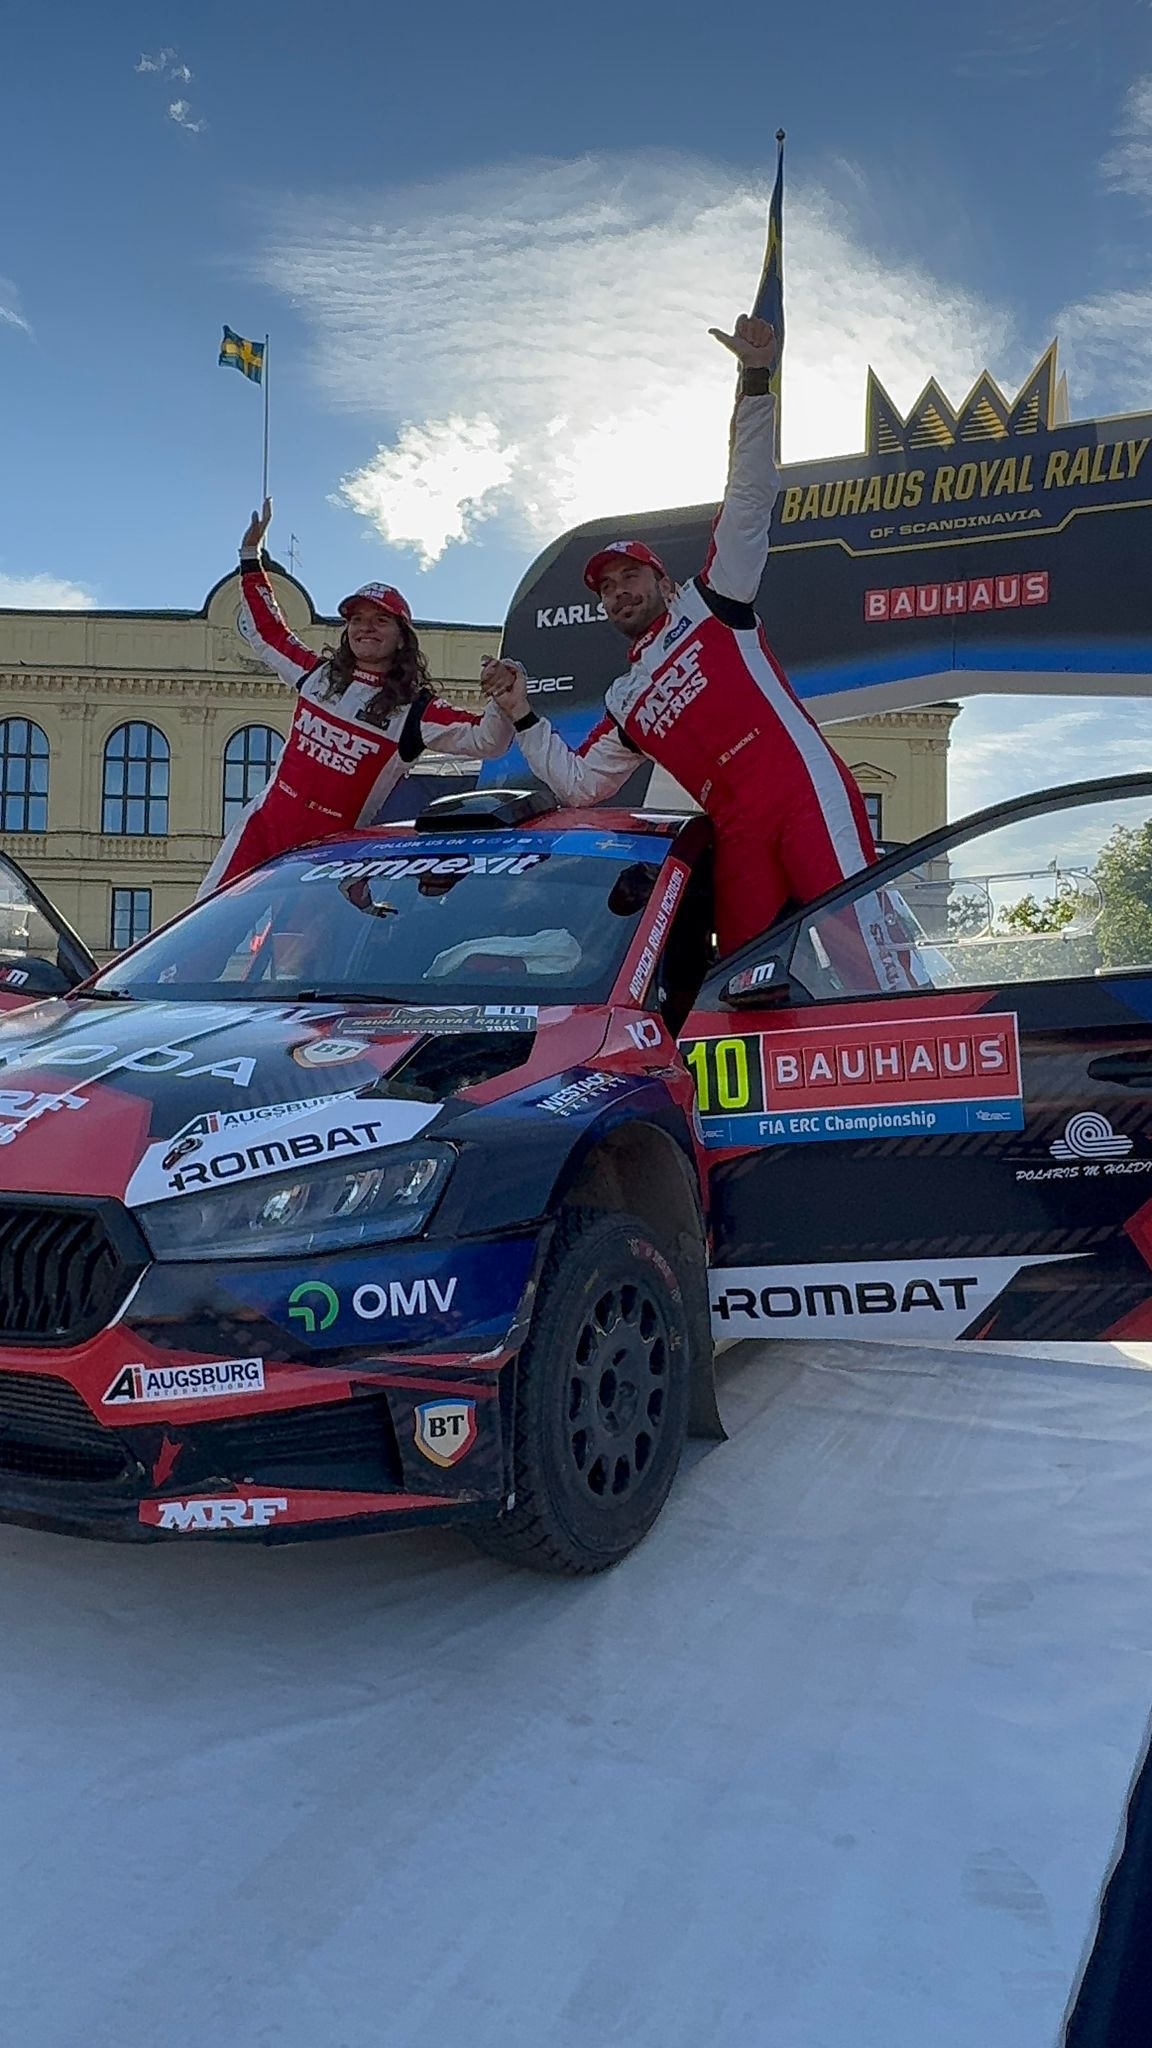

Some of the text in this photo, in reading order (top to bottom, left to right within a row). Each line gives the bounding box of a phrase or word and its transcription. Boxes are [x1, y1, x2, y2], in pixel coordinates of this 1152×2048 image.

[781, 437, 1152, 524] BAUHAUS ROYAL RALLY
[869, 508, 1042, 539] OF SCANDINAVIA
[868, 574, 1047, 619] BAUHAUS
[635, 640, 704, 737] MRF
[652, 670, 709, 739] TYRES
[294, 708, 380, 755] MRF
[296, 737, 358, 775] TYRES
[648, 910, 668, 951] RALLY
[687, 1039, 750, 1112] 10
[775, 1039, 1004, 1083] BAUHAUS
[759, 1110, 937, 1136] FIA ERC Championship
[168, 1124, 382, 1191] ROMBAT
[1015, 1166, 1080, 1181] POLARIS
[1083, 1165, 1100, 1176] M
[352, 1277, 457, 1319] OMV
[712, 1277, 978, 1320] ROMBAT
[146, 1362, 260, 1391] AUGSBURG
[428, 1414, 466, 1438] BT
[157, 1498, 288, 1532] MRF
